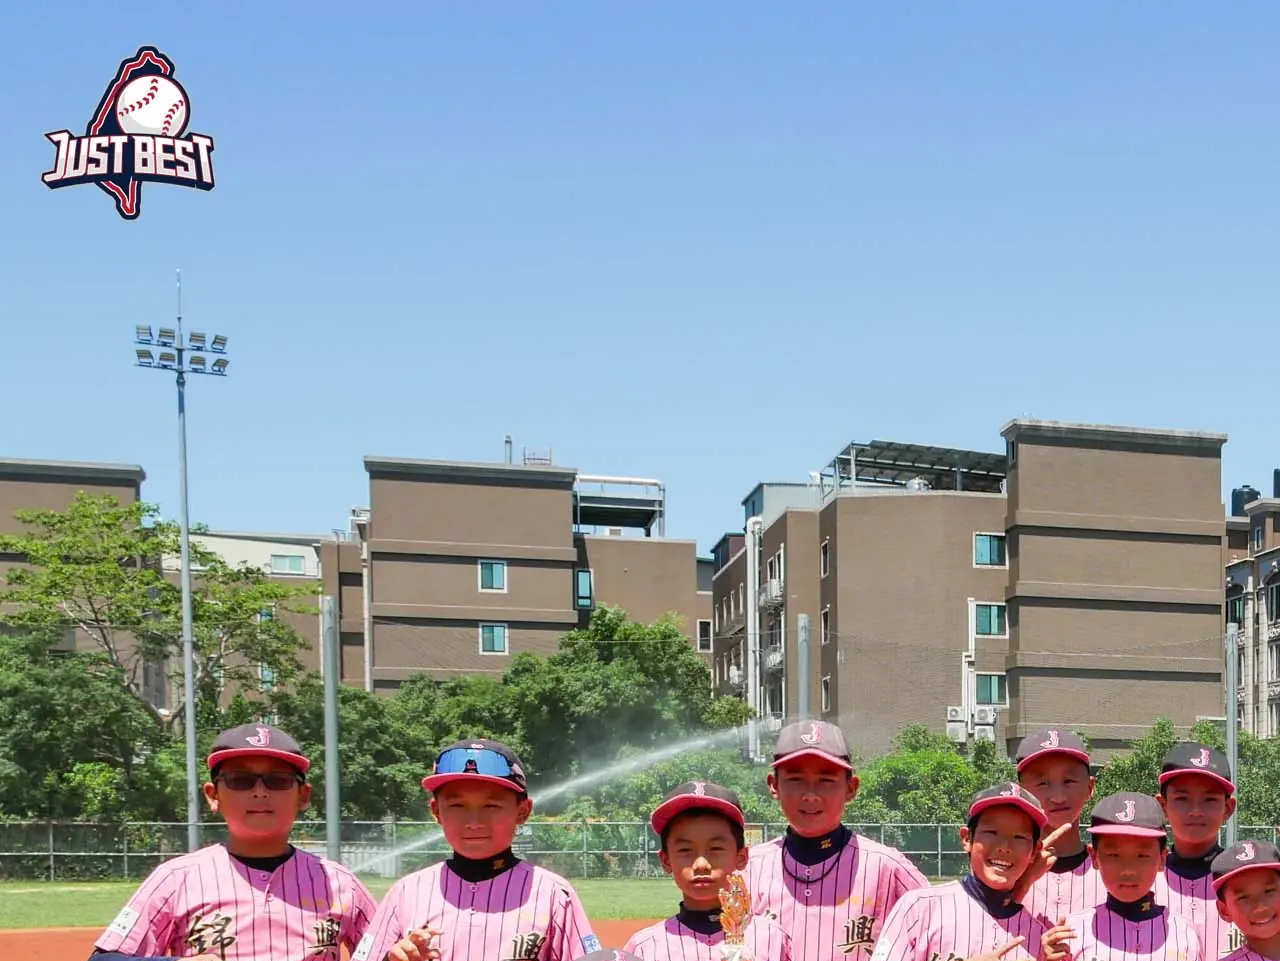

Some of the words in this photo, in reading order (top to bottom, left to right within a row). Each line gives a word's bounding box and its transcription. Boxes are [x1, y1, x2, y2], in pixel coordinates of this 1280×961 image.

[801, 723, 823, 744] J
[1040, 730, 1060, 748] J
[1190, 749, 1210, 768] J
[1115, 800, 1136, 821] J
[184, 913, 236, 961] 錦
[837, 915, 876, 954] 興
